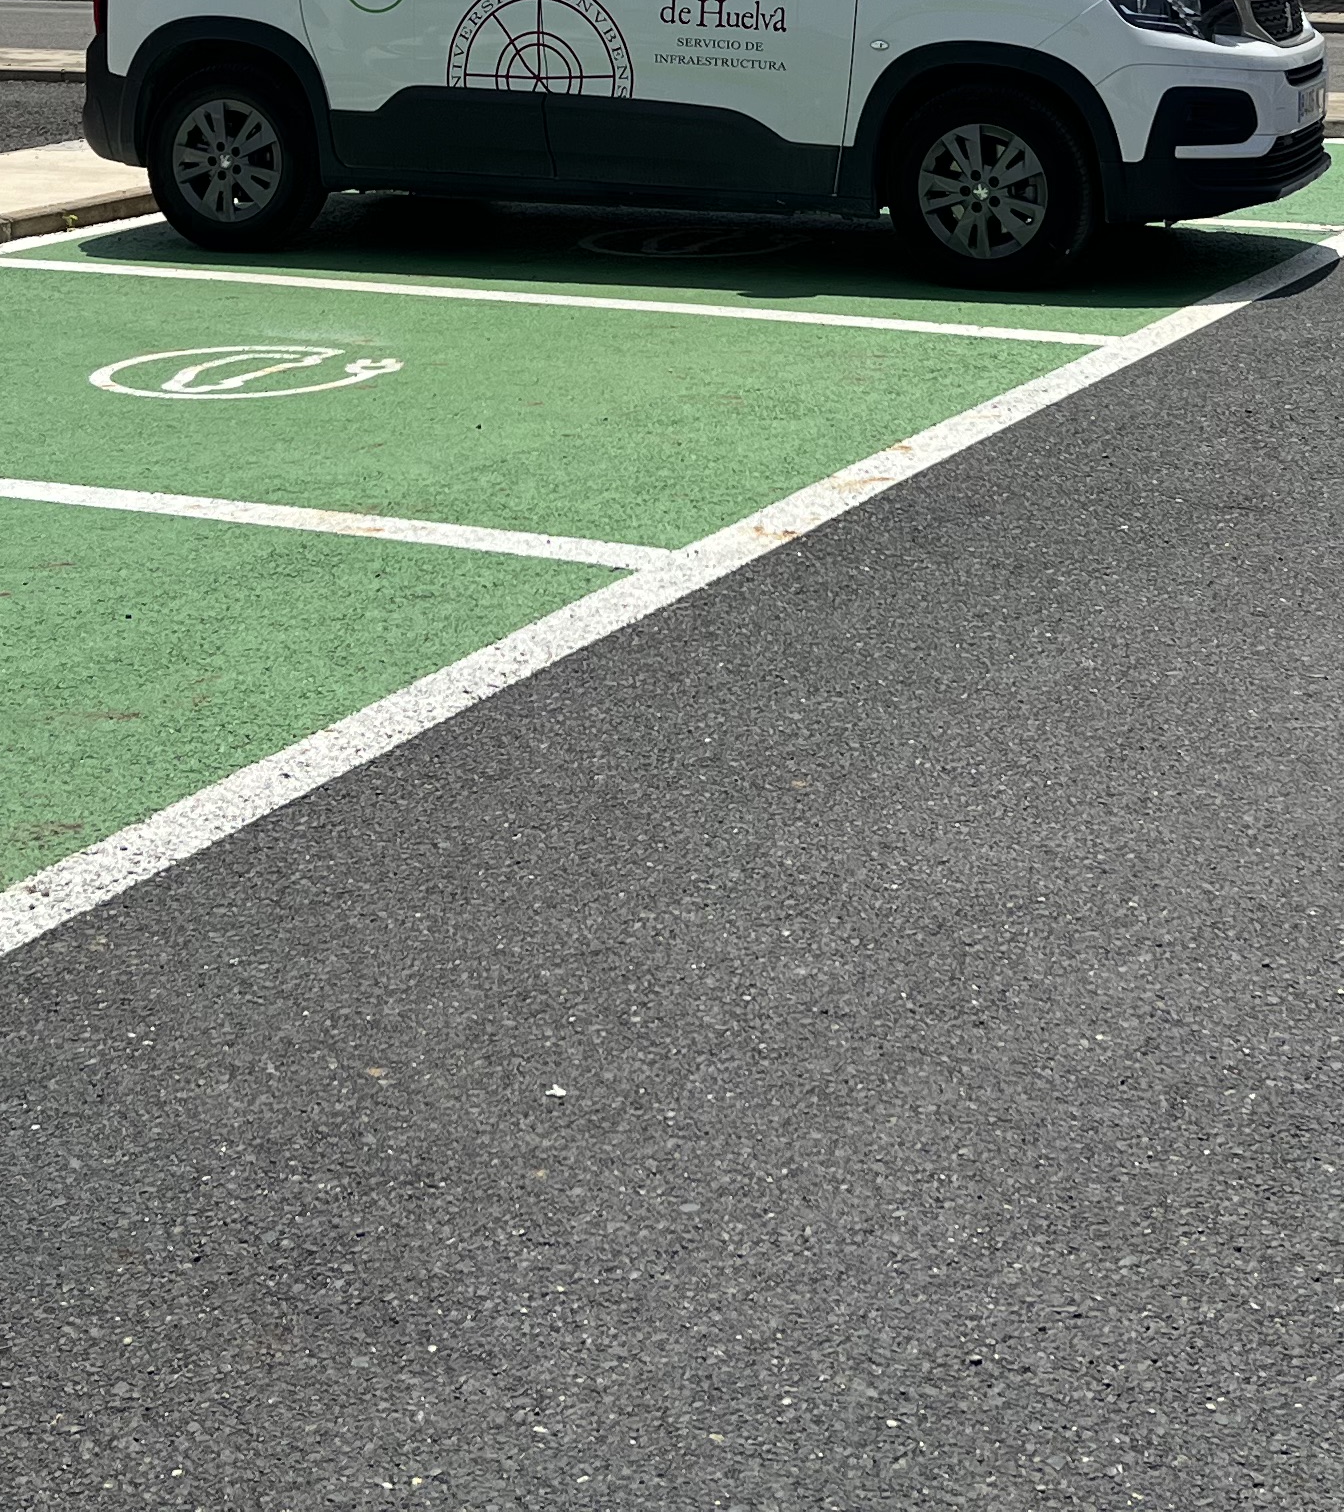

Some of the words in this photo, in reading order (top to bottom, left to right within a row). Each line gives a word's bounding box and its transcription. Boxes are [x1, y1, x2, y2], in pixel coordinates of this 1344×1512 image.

[676, 37, 741, 51] SERVICIO
[744, 41, 764, 52] DE
[654, 53, 787, 72] INFRAESTRUCTURA
